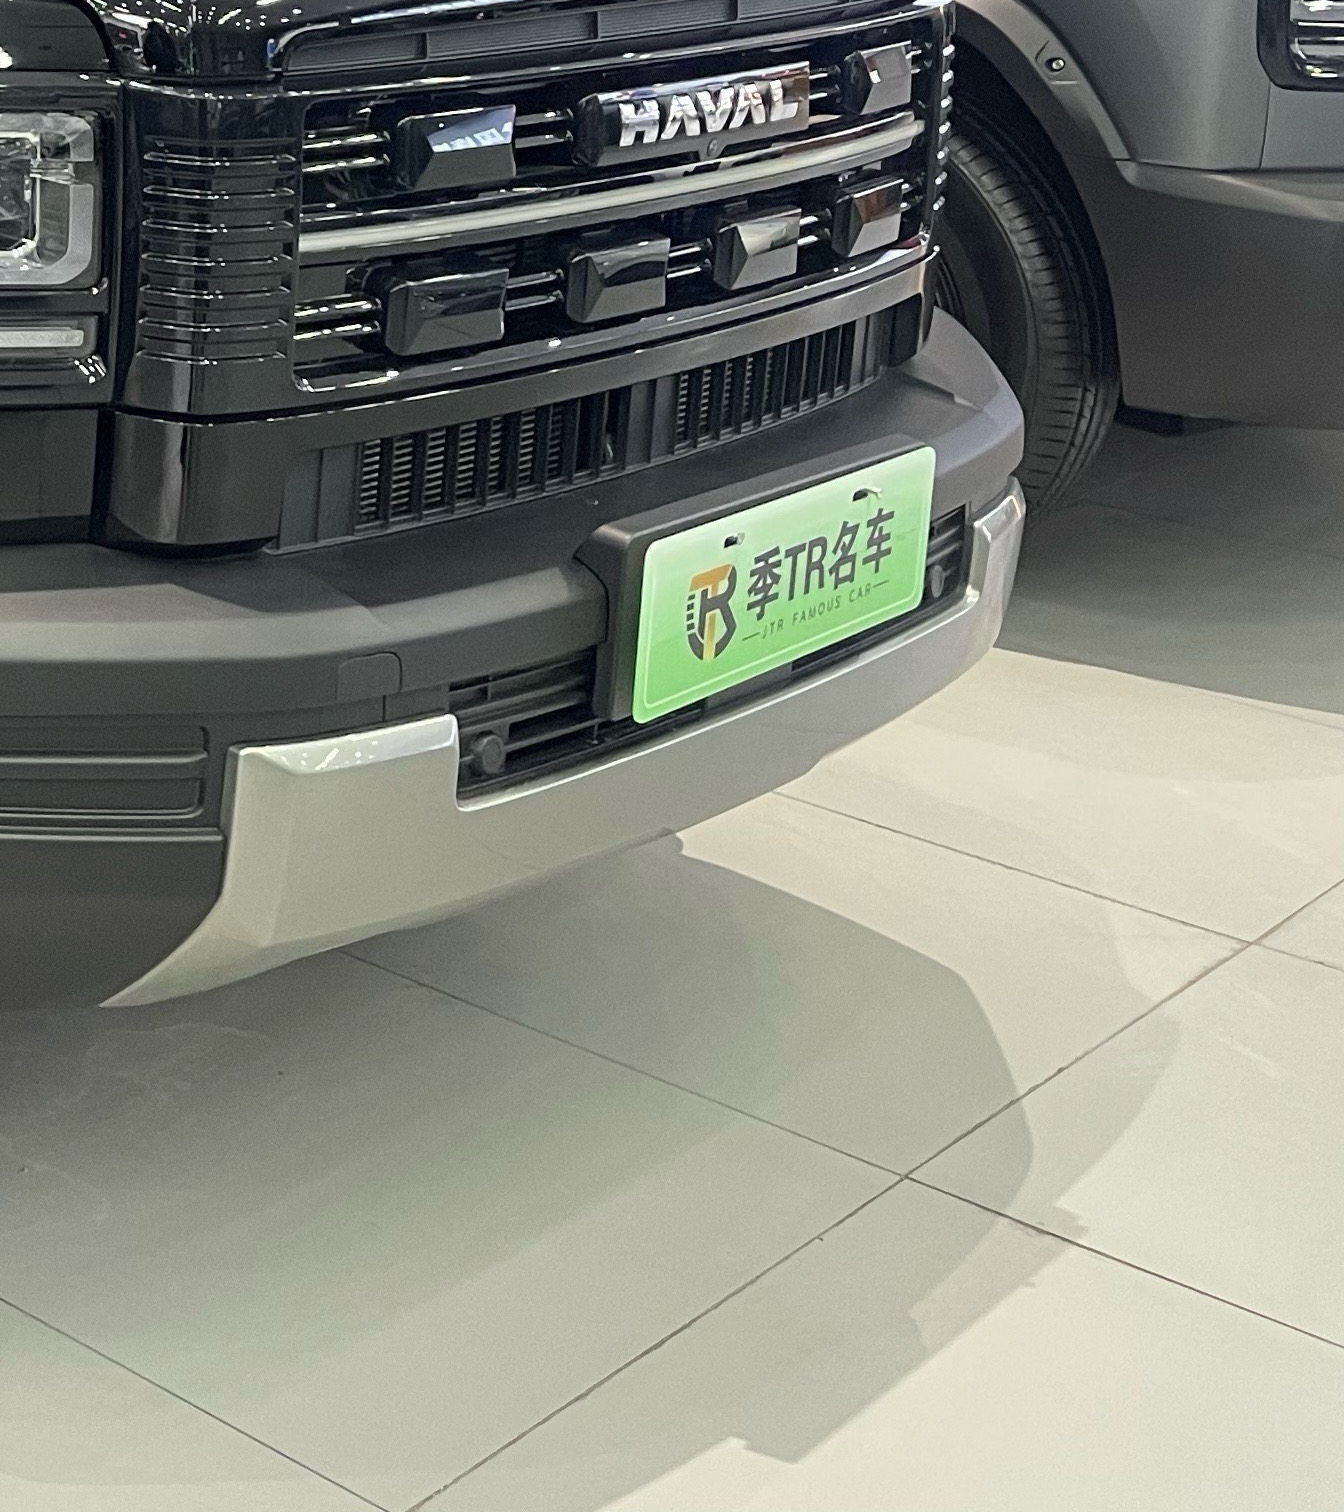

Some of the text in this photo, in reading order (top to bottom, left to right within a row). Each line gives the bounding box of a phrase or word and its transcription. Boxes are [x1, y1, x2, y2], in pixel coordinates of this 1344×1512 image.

[618, 79, 799, 147] HAVAL
[746, 507, 896, 622] 季TR名车
[762, 583, 872, 640] JTR FAMOUS CAR
